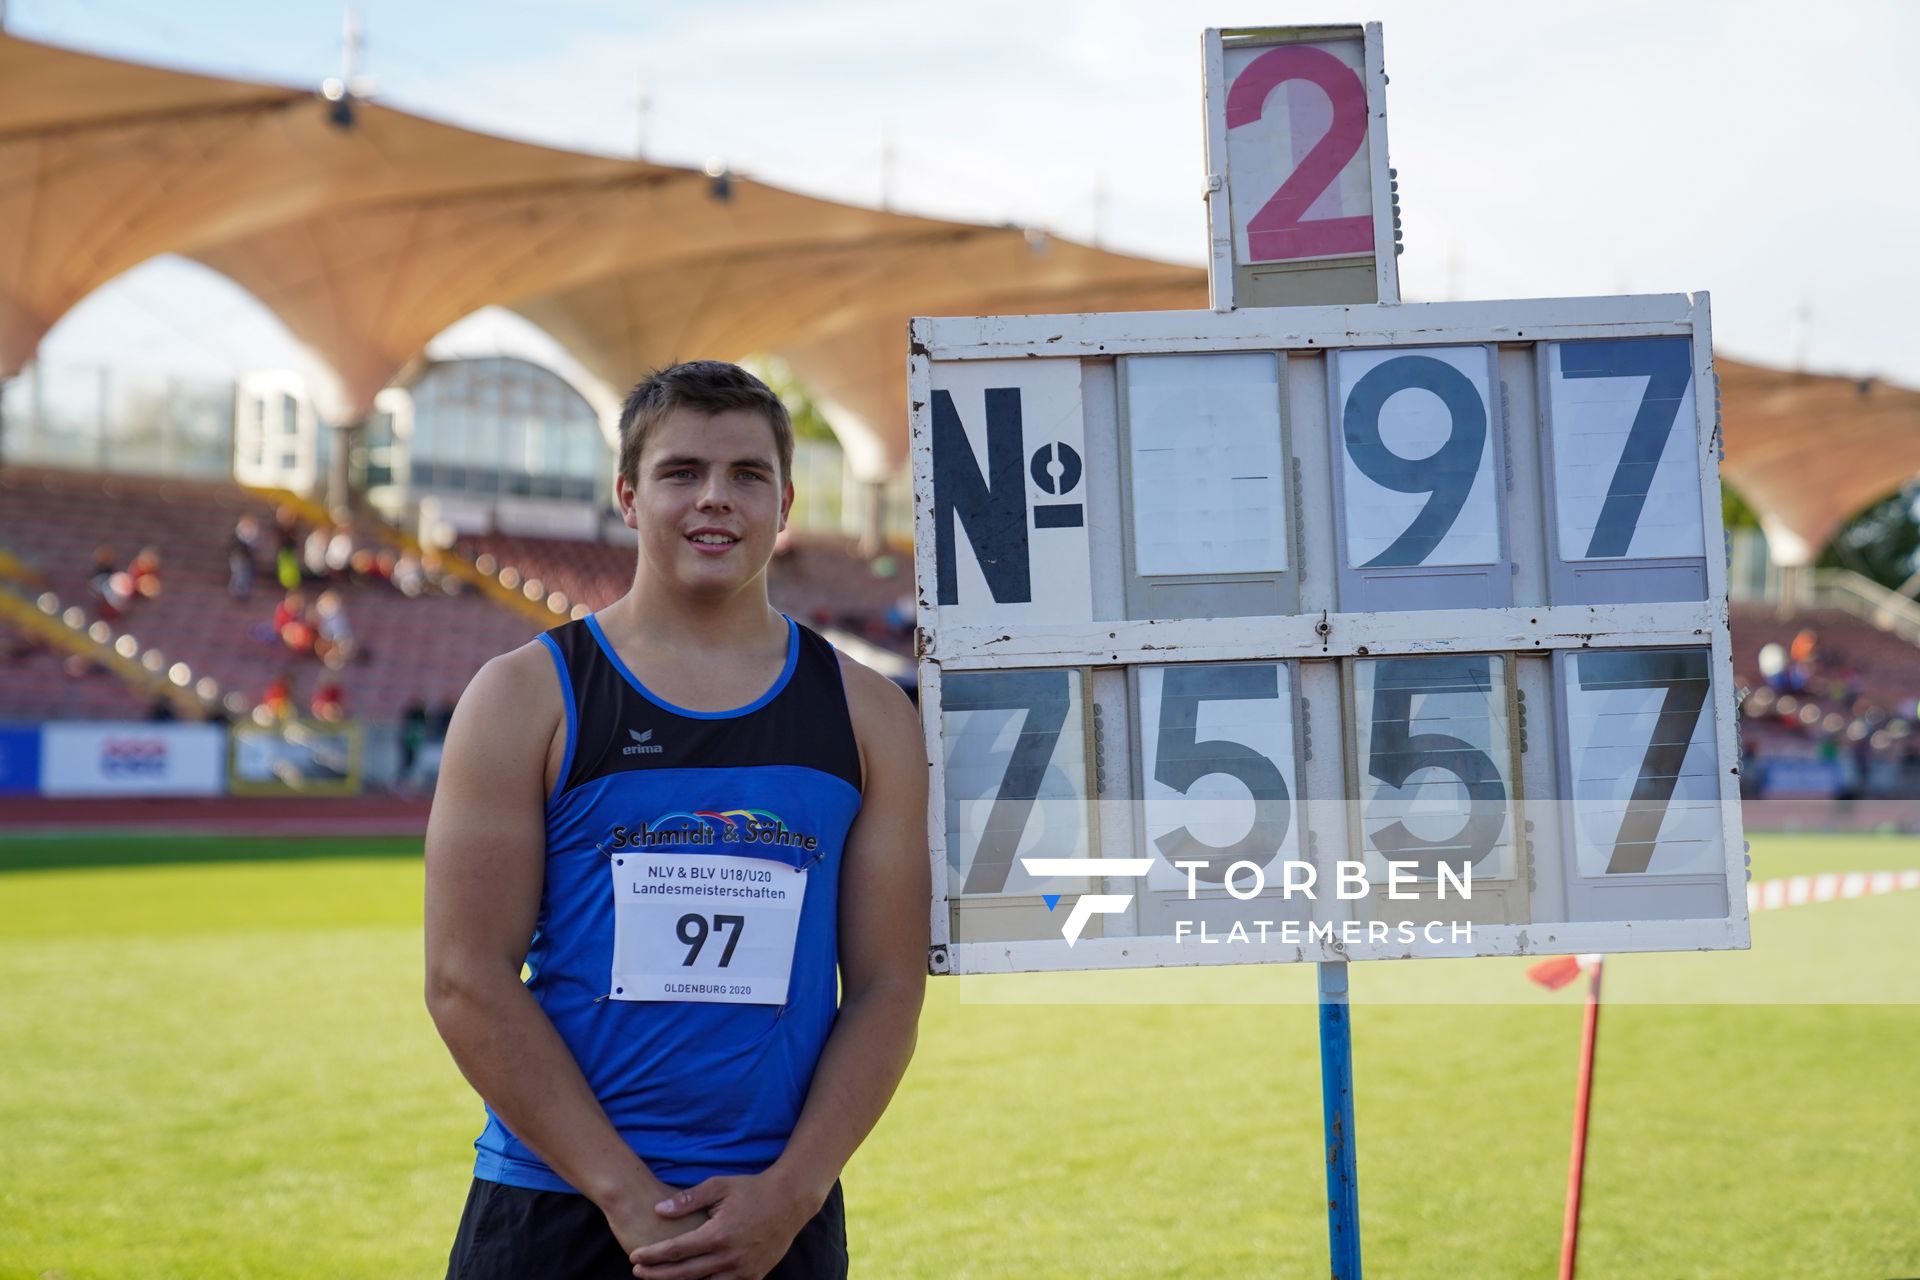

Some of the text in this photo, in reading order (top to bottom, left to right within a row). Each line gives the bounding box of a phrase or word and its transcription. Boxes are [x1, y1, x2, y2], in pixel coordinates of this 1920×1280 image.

[1226, 45, 1375, 262] 2
[1343, 336, 1692, 568] 97
[622, 743, 663, 755] erima
[612, 820, 818, 851] Schmidt & Söhne
[648, 866, 772, 883] NLV & BLV U18/U20
[632, 882, 786, 900] Landesmeisterschaften
[676, 913, 745, 968] 97
[664, 983, 752, 996] OLDENBURG 2020
